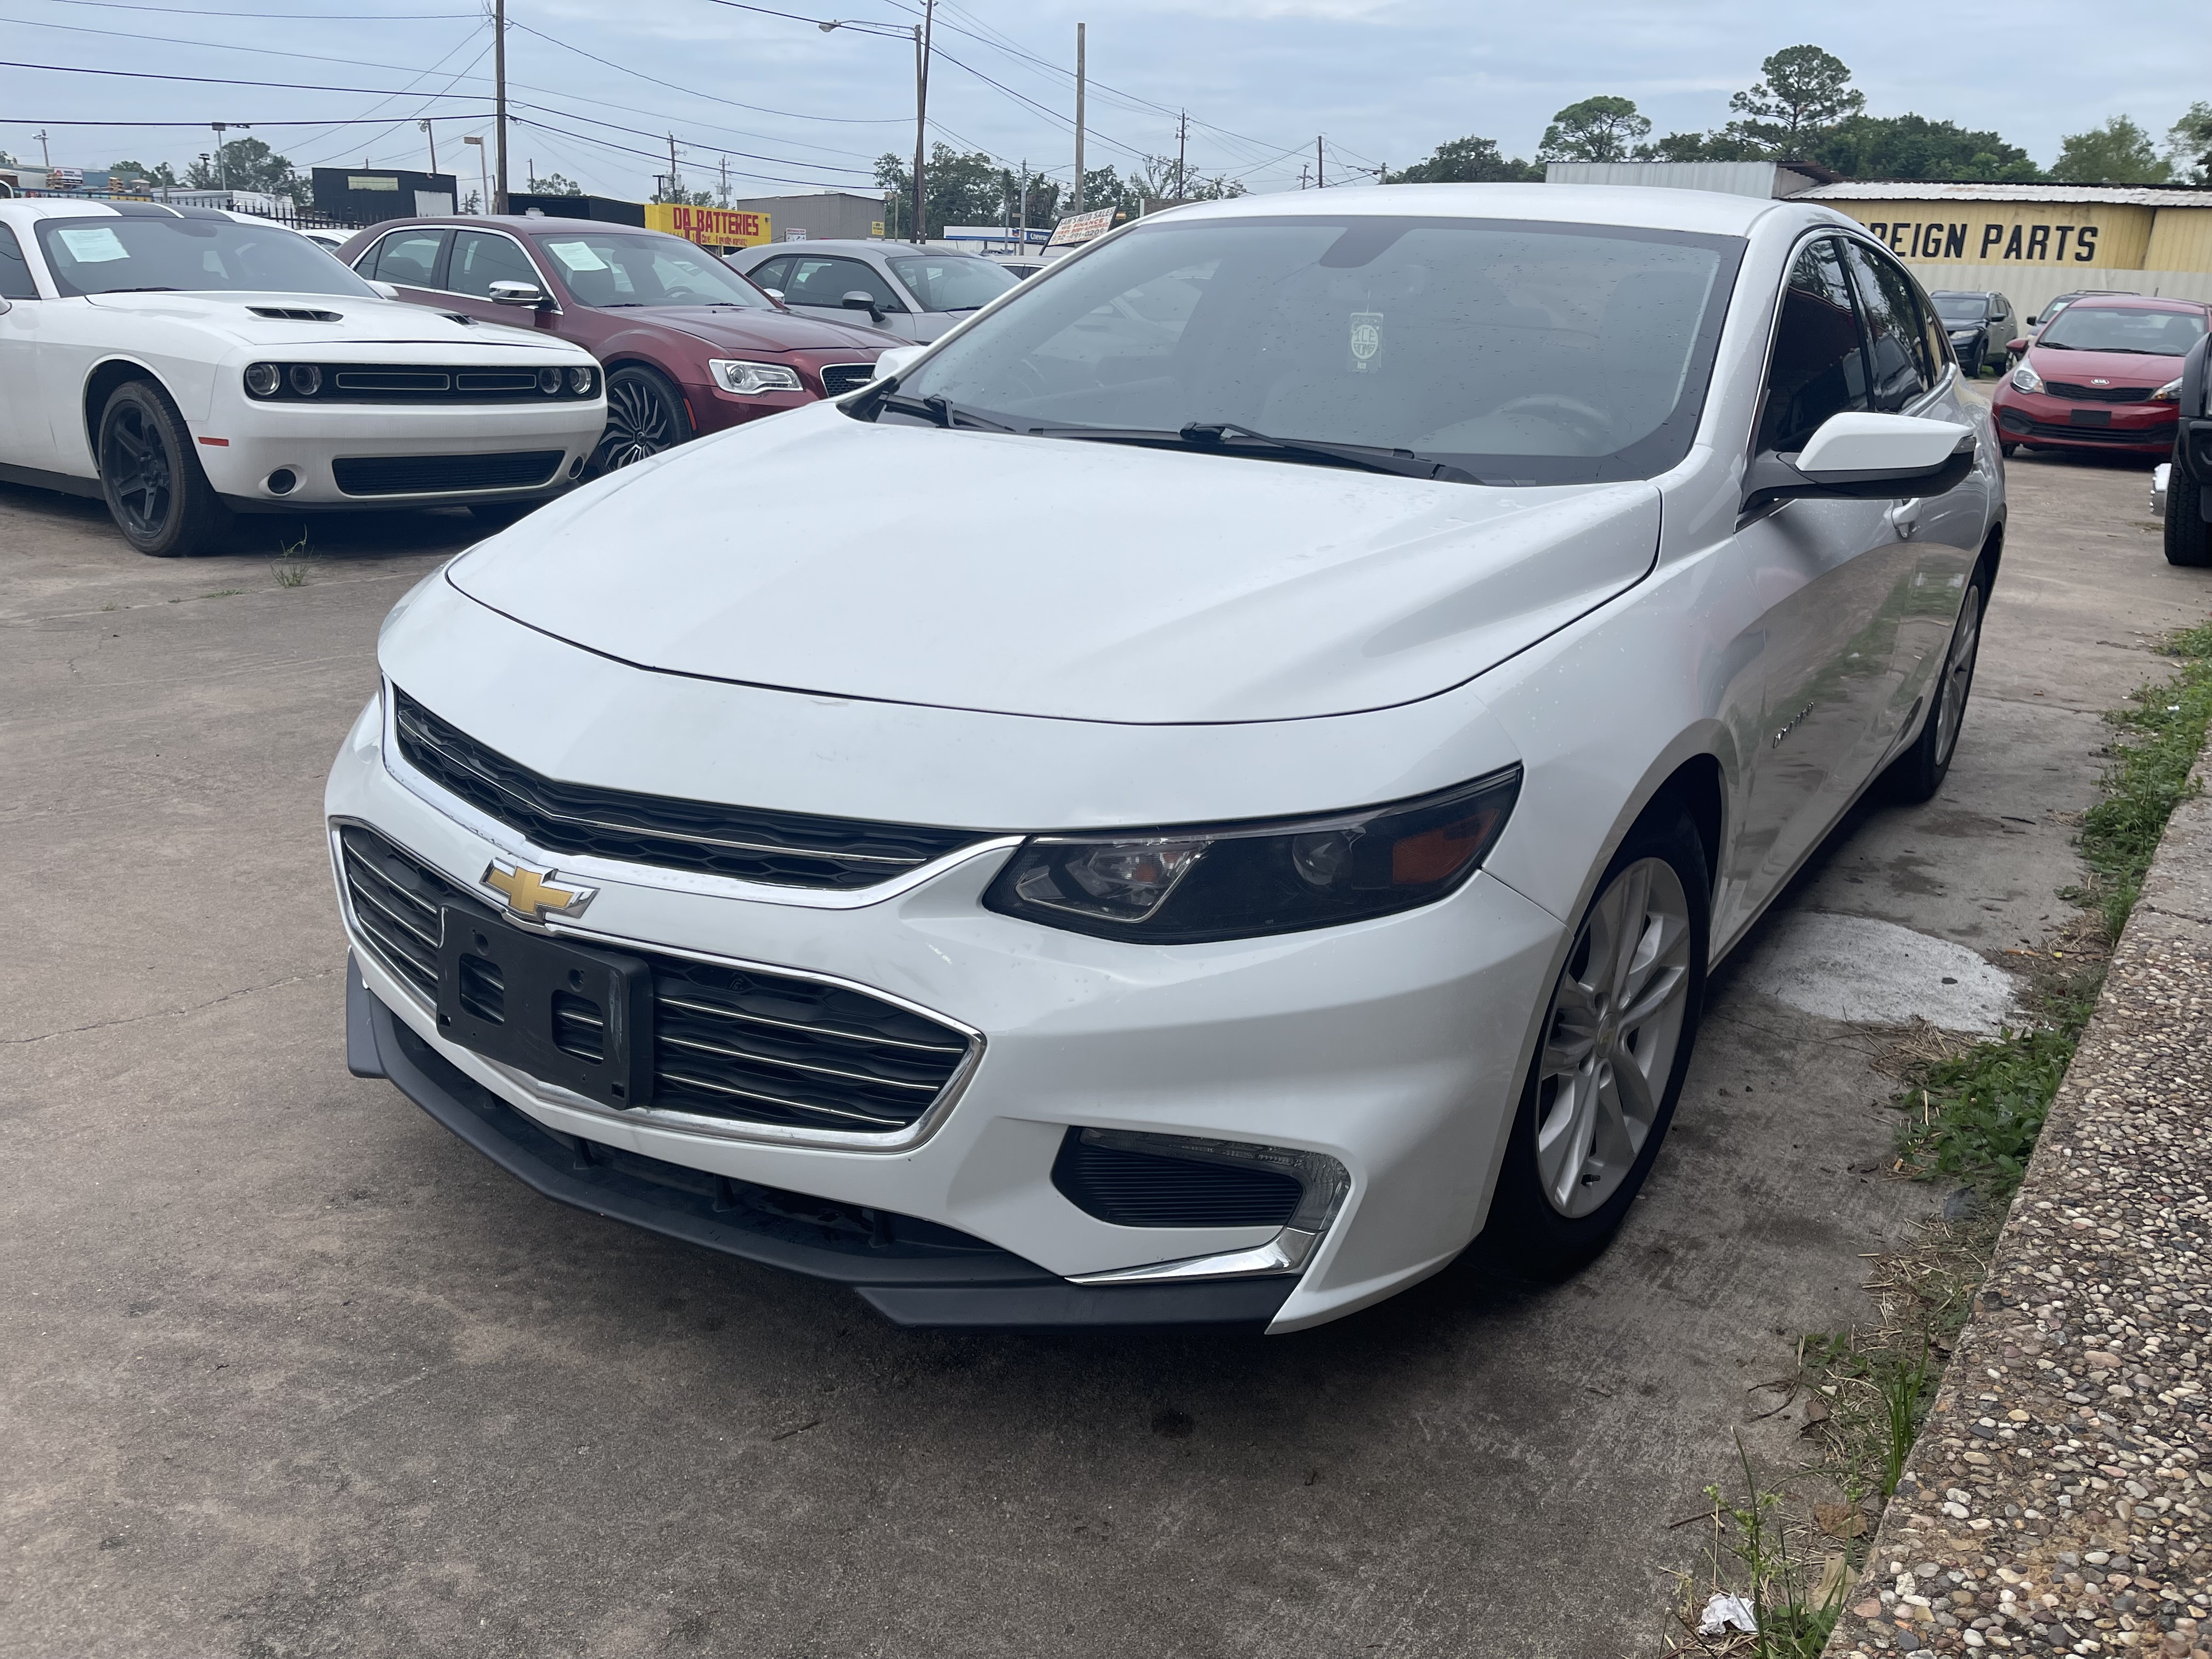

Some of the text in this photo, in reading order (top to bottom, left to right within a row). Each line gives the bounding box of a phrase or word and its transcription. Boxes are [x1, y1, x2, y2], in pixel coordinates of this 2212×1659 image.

[673, 207, 691, 230] DA
[696, 210, 759, 236] BATTERIES
[1074, 218, 1104, 228] FINANCE
[1079, 214, 1092, 222] AUTO
[1094, 208, 1114, 219] SALES
[1980, 223, 2099, 262] PARTS
